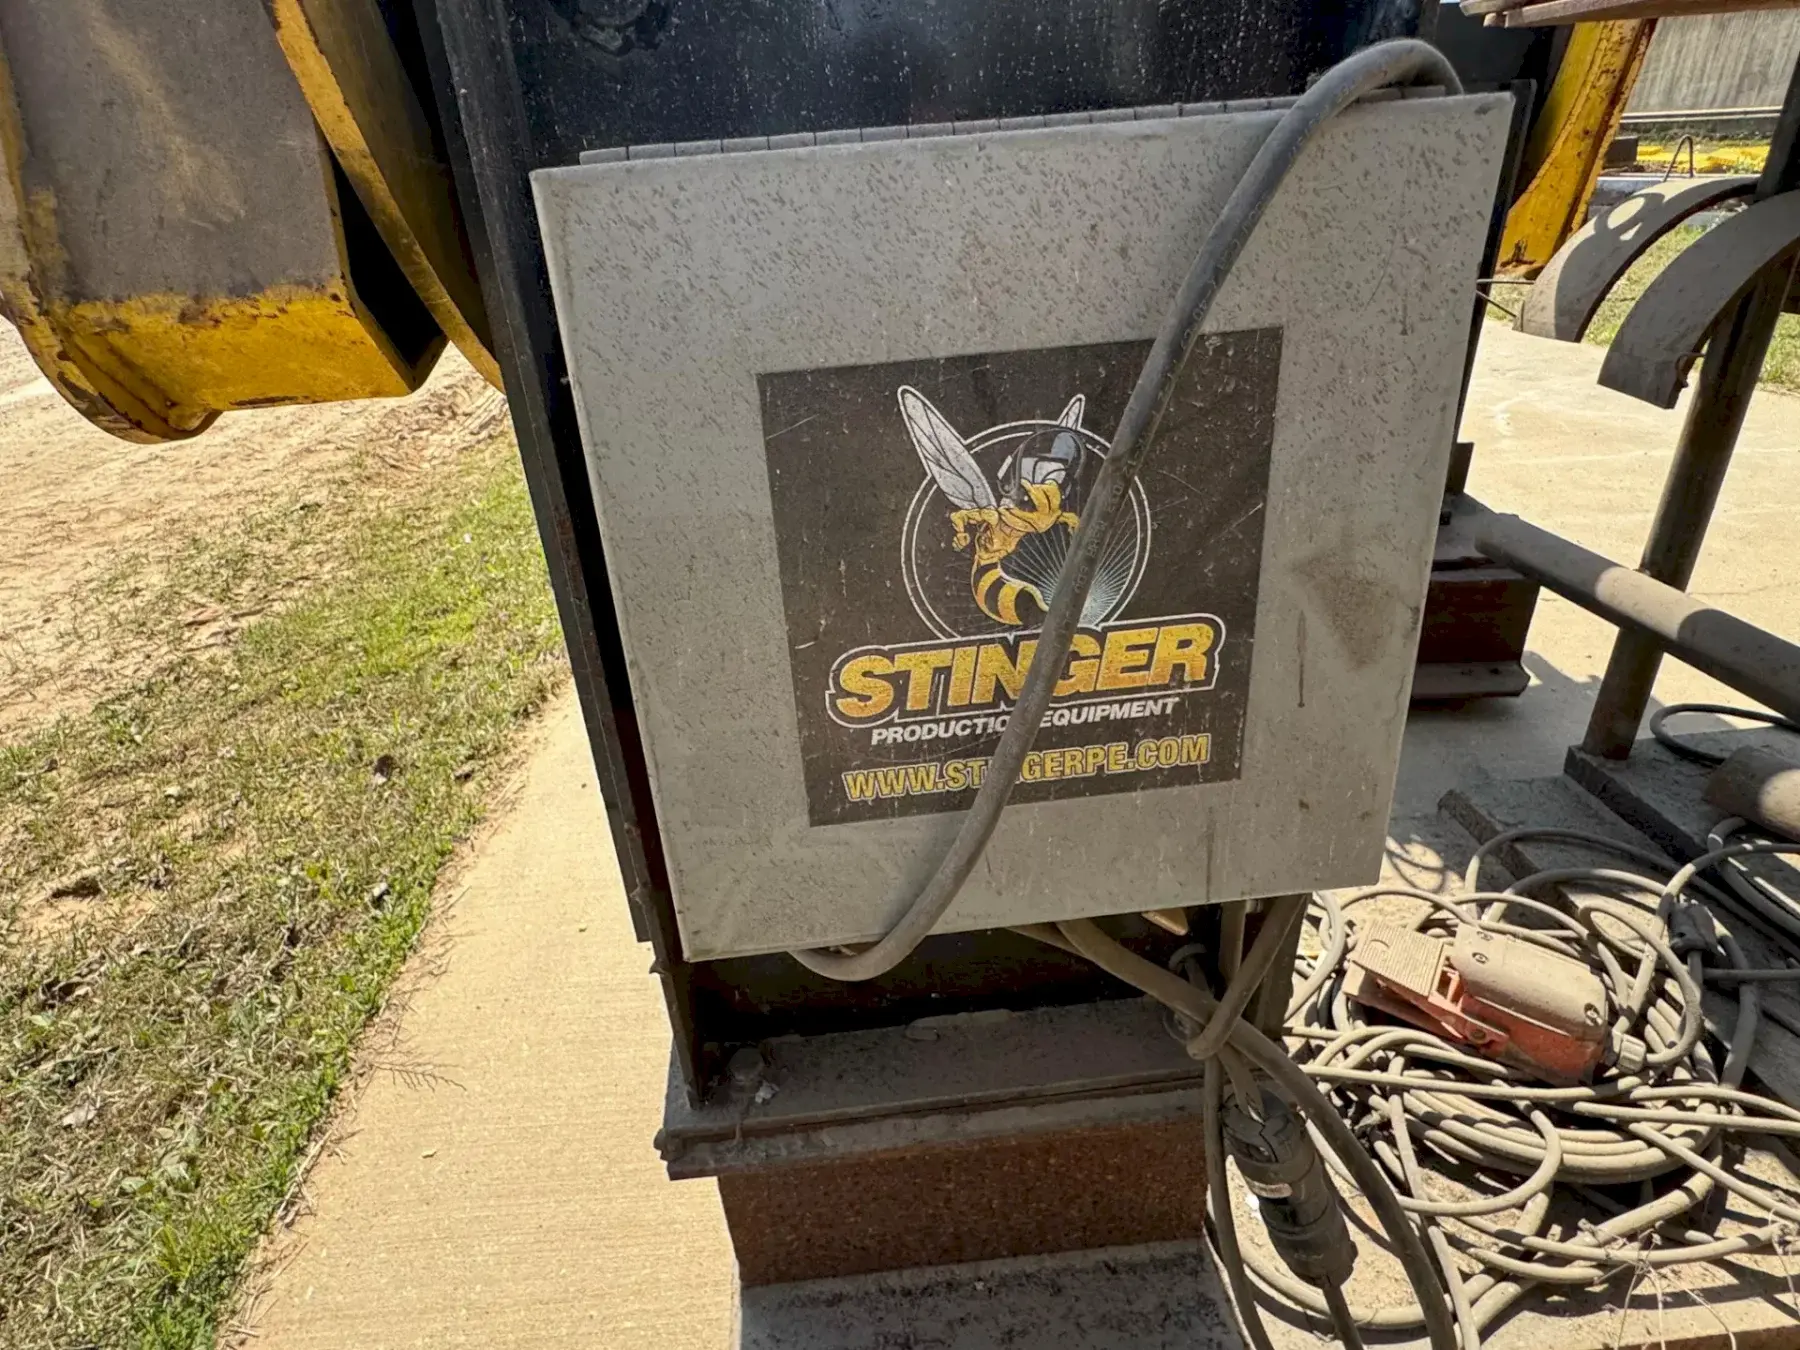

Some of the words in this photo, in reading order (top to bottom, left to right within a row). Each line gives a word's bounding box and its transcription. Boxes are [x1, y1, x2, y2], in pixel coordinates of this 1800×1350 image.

[833, 621, 1216, 719] STINGER
[870, 713, 1012, 746] PRODUCTIO
[1039, 697, 1180, 729] EQUIPMENT
[843, 734, 1211, 801] WWW.STGERPE.COM
